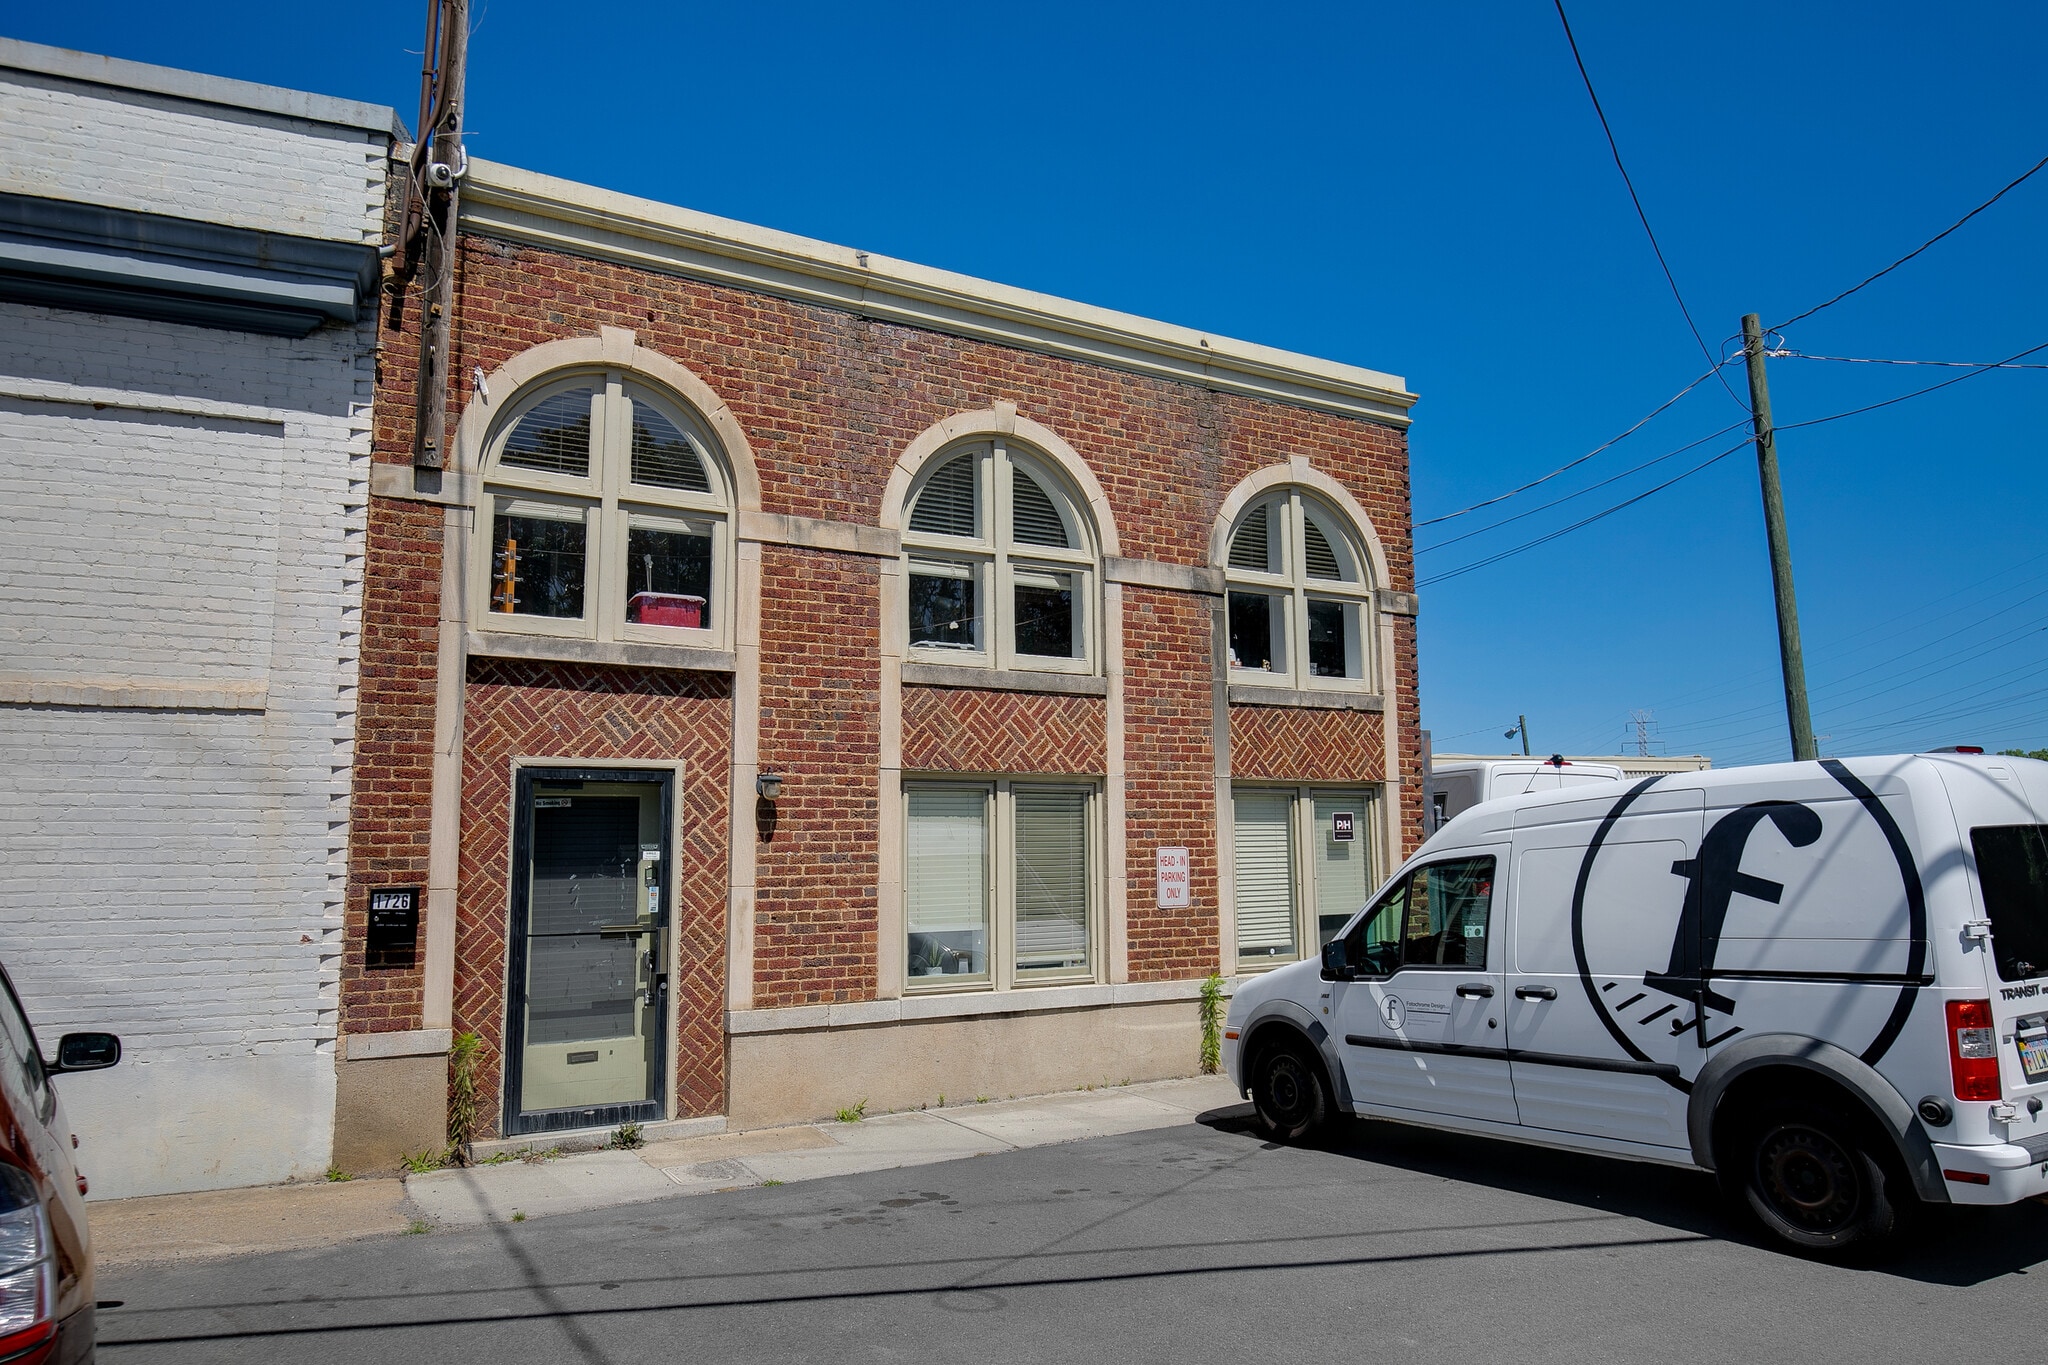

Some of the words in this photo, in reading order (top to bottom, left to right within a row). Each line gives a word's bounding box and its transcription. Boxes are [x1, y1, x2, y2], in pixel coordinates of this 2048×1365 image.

[1160, 856, 1175, 866] HEAD
[1180, 856, 1185, 866] IN
[1161, 872, 1185, 882] PARKING
[1167, 888, 1181, 898] ONLY
[376, 894, 409, 908] 1726
[2000, 984, 2040, 1000] TRANSIT
